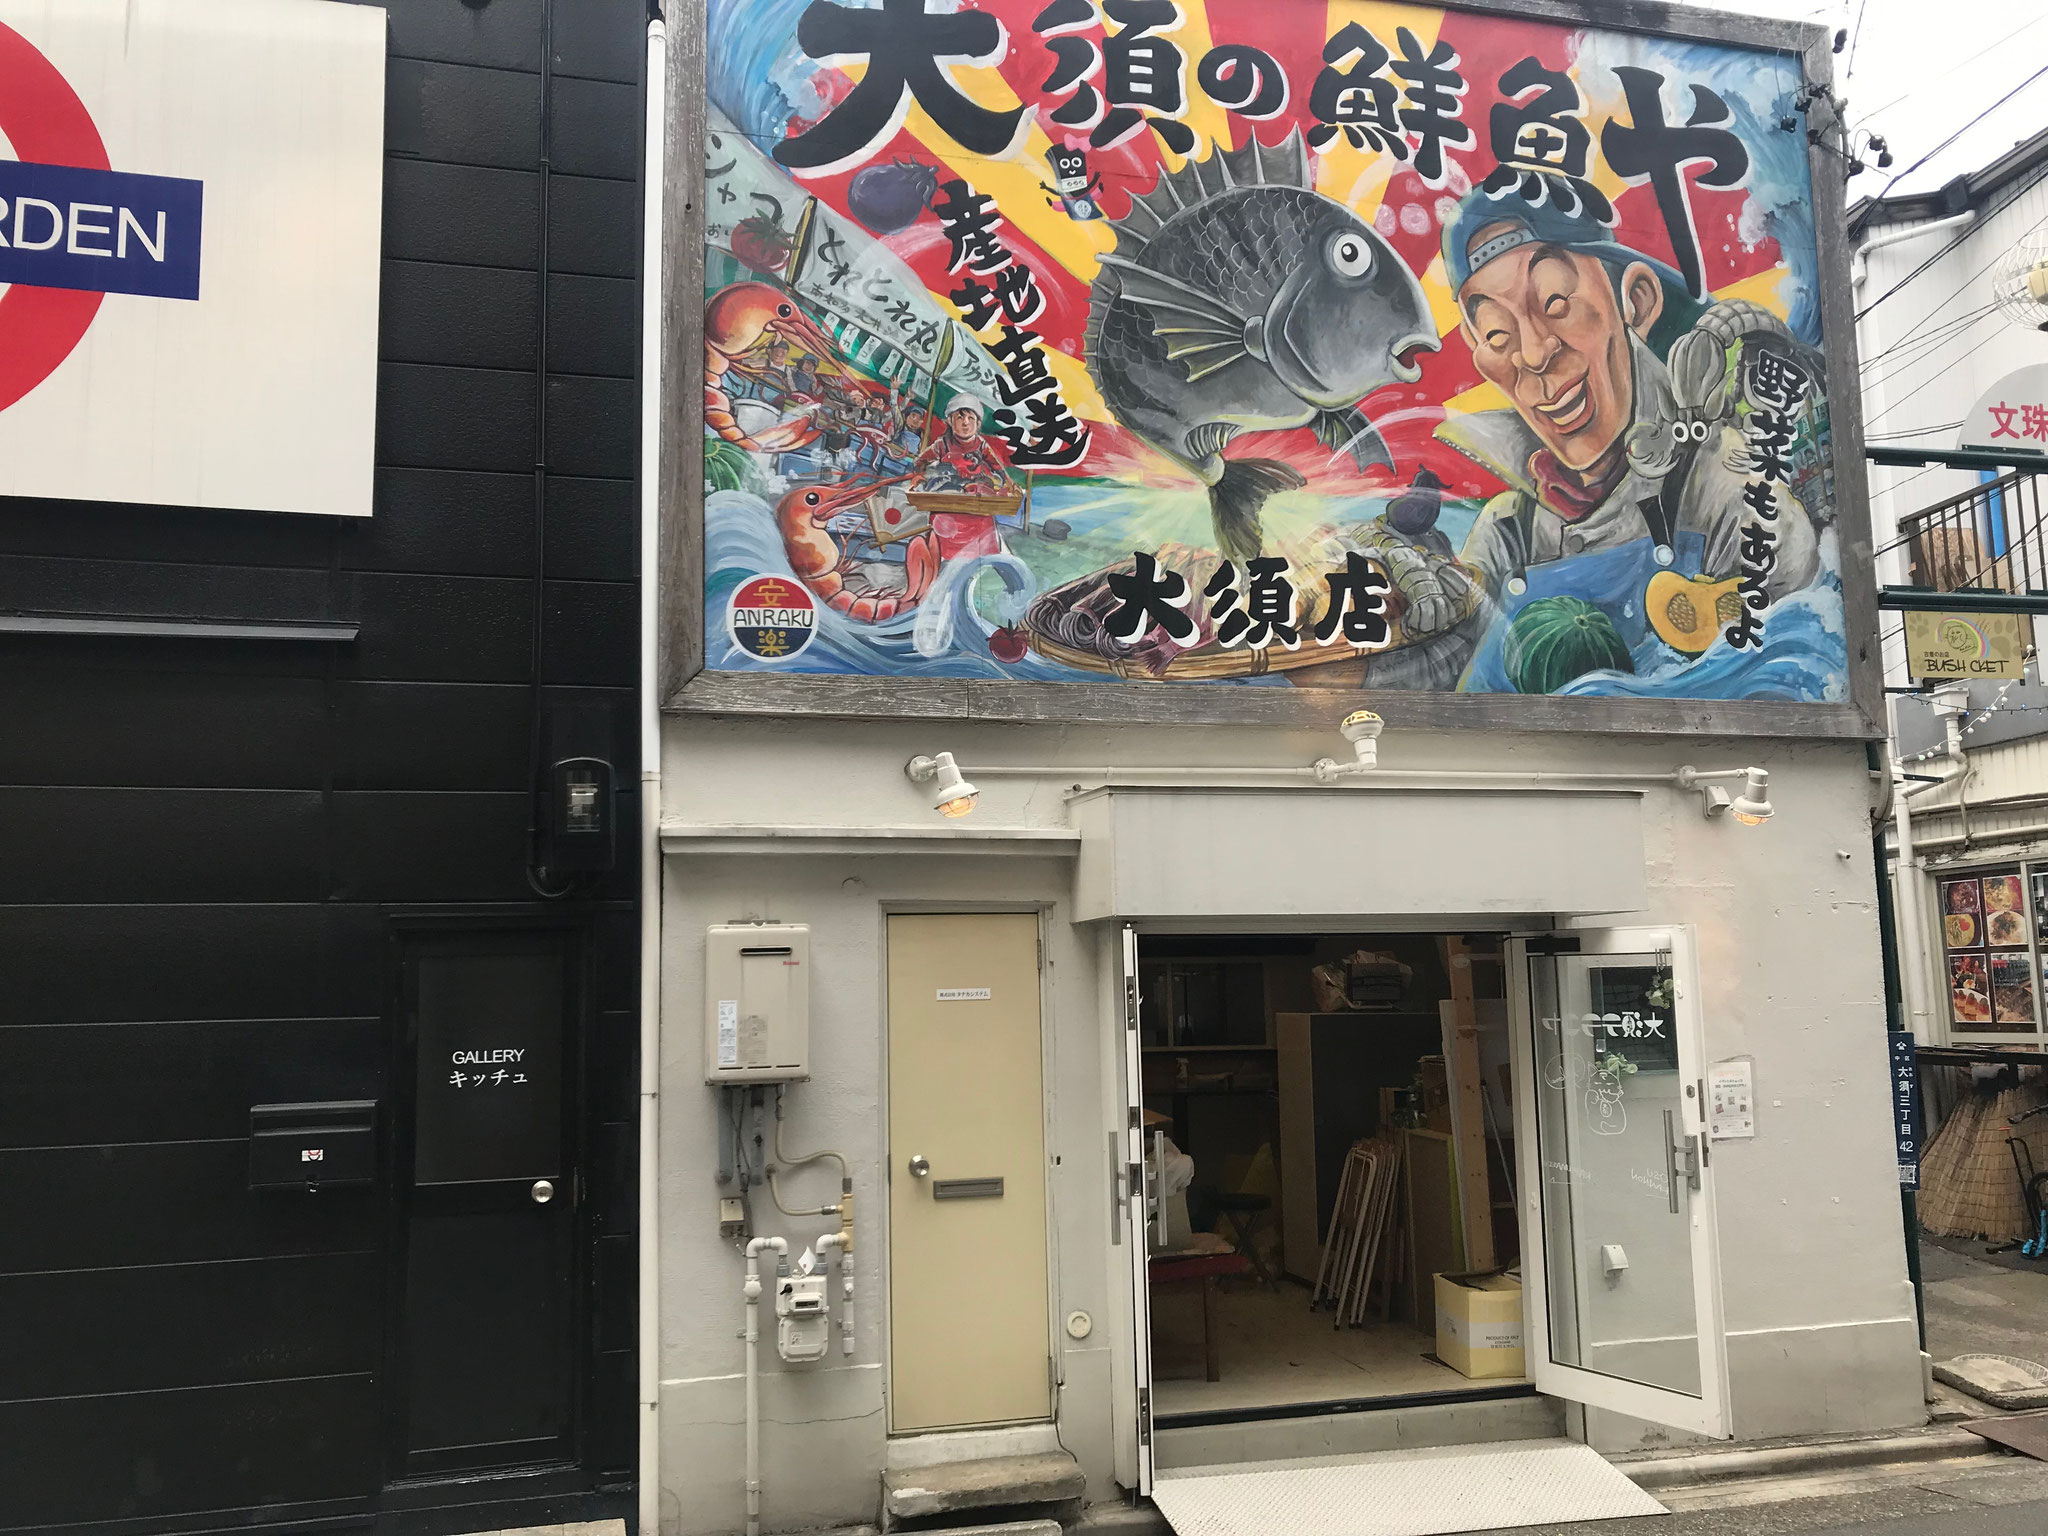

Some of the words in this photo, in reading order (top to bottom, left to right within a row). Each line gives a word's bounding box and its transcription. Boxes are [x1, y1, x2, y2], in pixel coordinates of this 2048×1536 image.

[772, 0, 1750, 303] 大須の鮮魚や
[0, 196, 167, 262] DEN
[932, 177, 1090, 468] 産地直送
[1988, 401, 2048, 442] 文珠
[1725, 350, 1809, 650] 野菜もあるよ
[753, 579, 790, 607] 安
[1103, 551, 1390, 650] 大須店
[734, 609, 814, 628] ANRAKU
[1925, 659, 1966, 673] BUSH
[452, 1048, 525, 1065] GALLERY
[449, 1068, 528, 1088] キッチュ
[1898, 1066, 1911, 1136] 大須三丁目
[1899, 1141, 1914, 1152] 42
